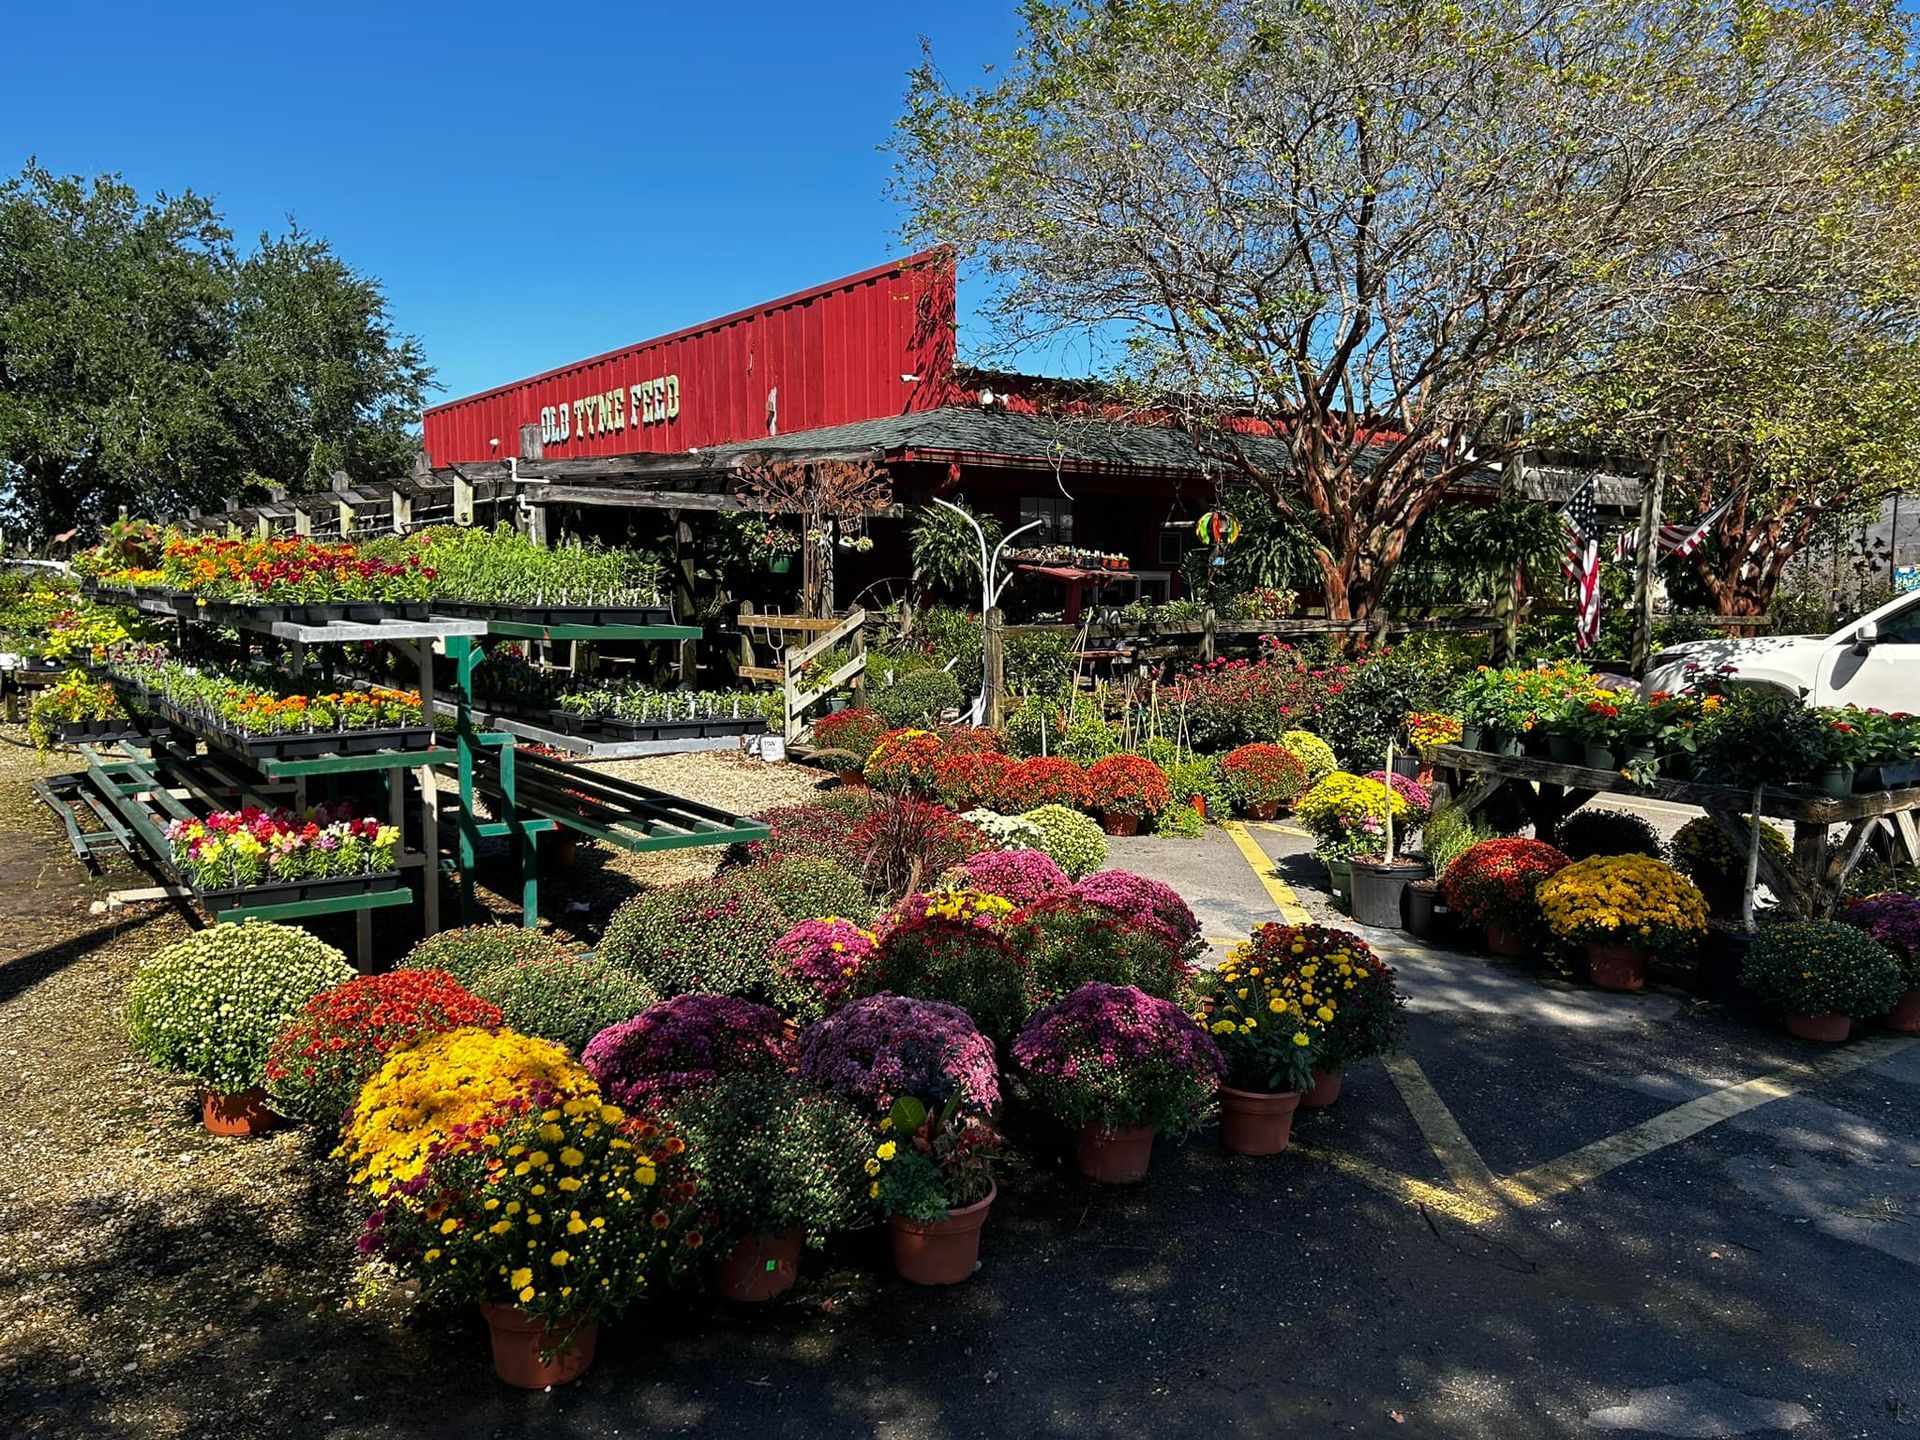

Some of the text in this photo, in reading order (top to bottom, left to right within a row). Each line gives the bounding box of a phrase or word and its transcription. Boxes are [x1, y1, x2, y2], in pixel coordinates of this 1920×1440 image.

[541, 375, 679, 444] OLD TYME FEED
